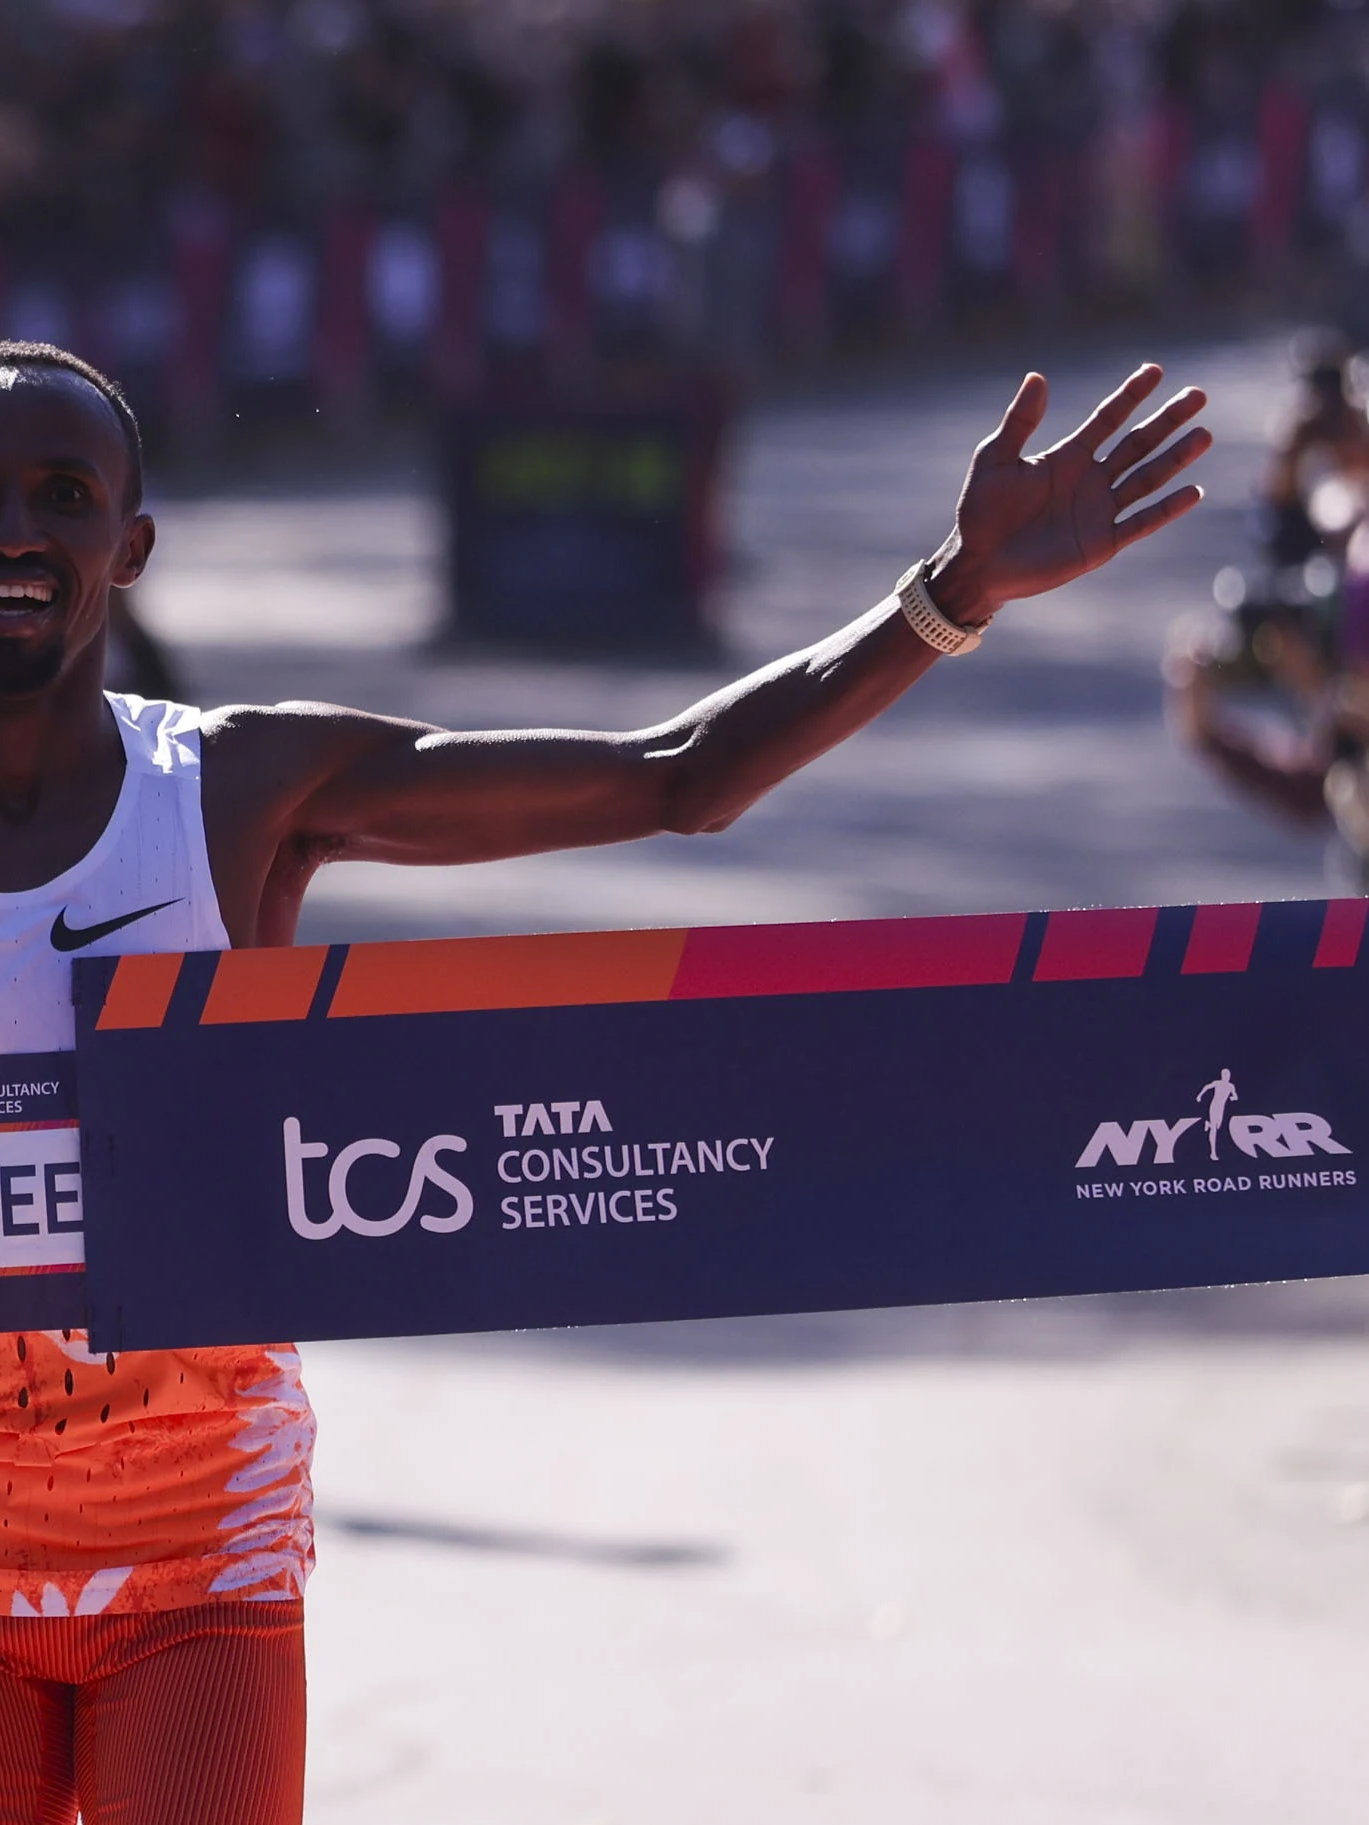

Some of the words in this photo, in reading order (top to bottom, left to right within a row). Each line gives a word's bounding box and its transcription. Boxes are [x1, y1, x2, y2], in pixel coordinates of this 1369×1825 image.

[493, 1099, 614, 1138] TATA
[283, 1116, 474, 1241] tcs
[496, 1137, 775, 1184] CONSULTANCY
[1076, 1182, 1124, 1200] NEW
[1129, 1179, 1187, 1197] YORK
[1193, 1176, 1252, 1194] ROAD
[1258, 1170, 1357, 1190] RUNNERS
[500, 1188, 678, 1230] SERVICES
